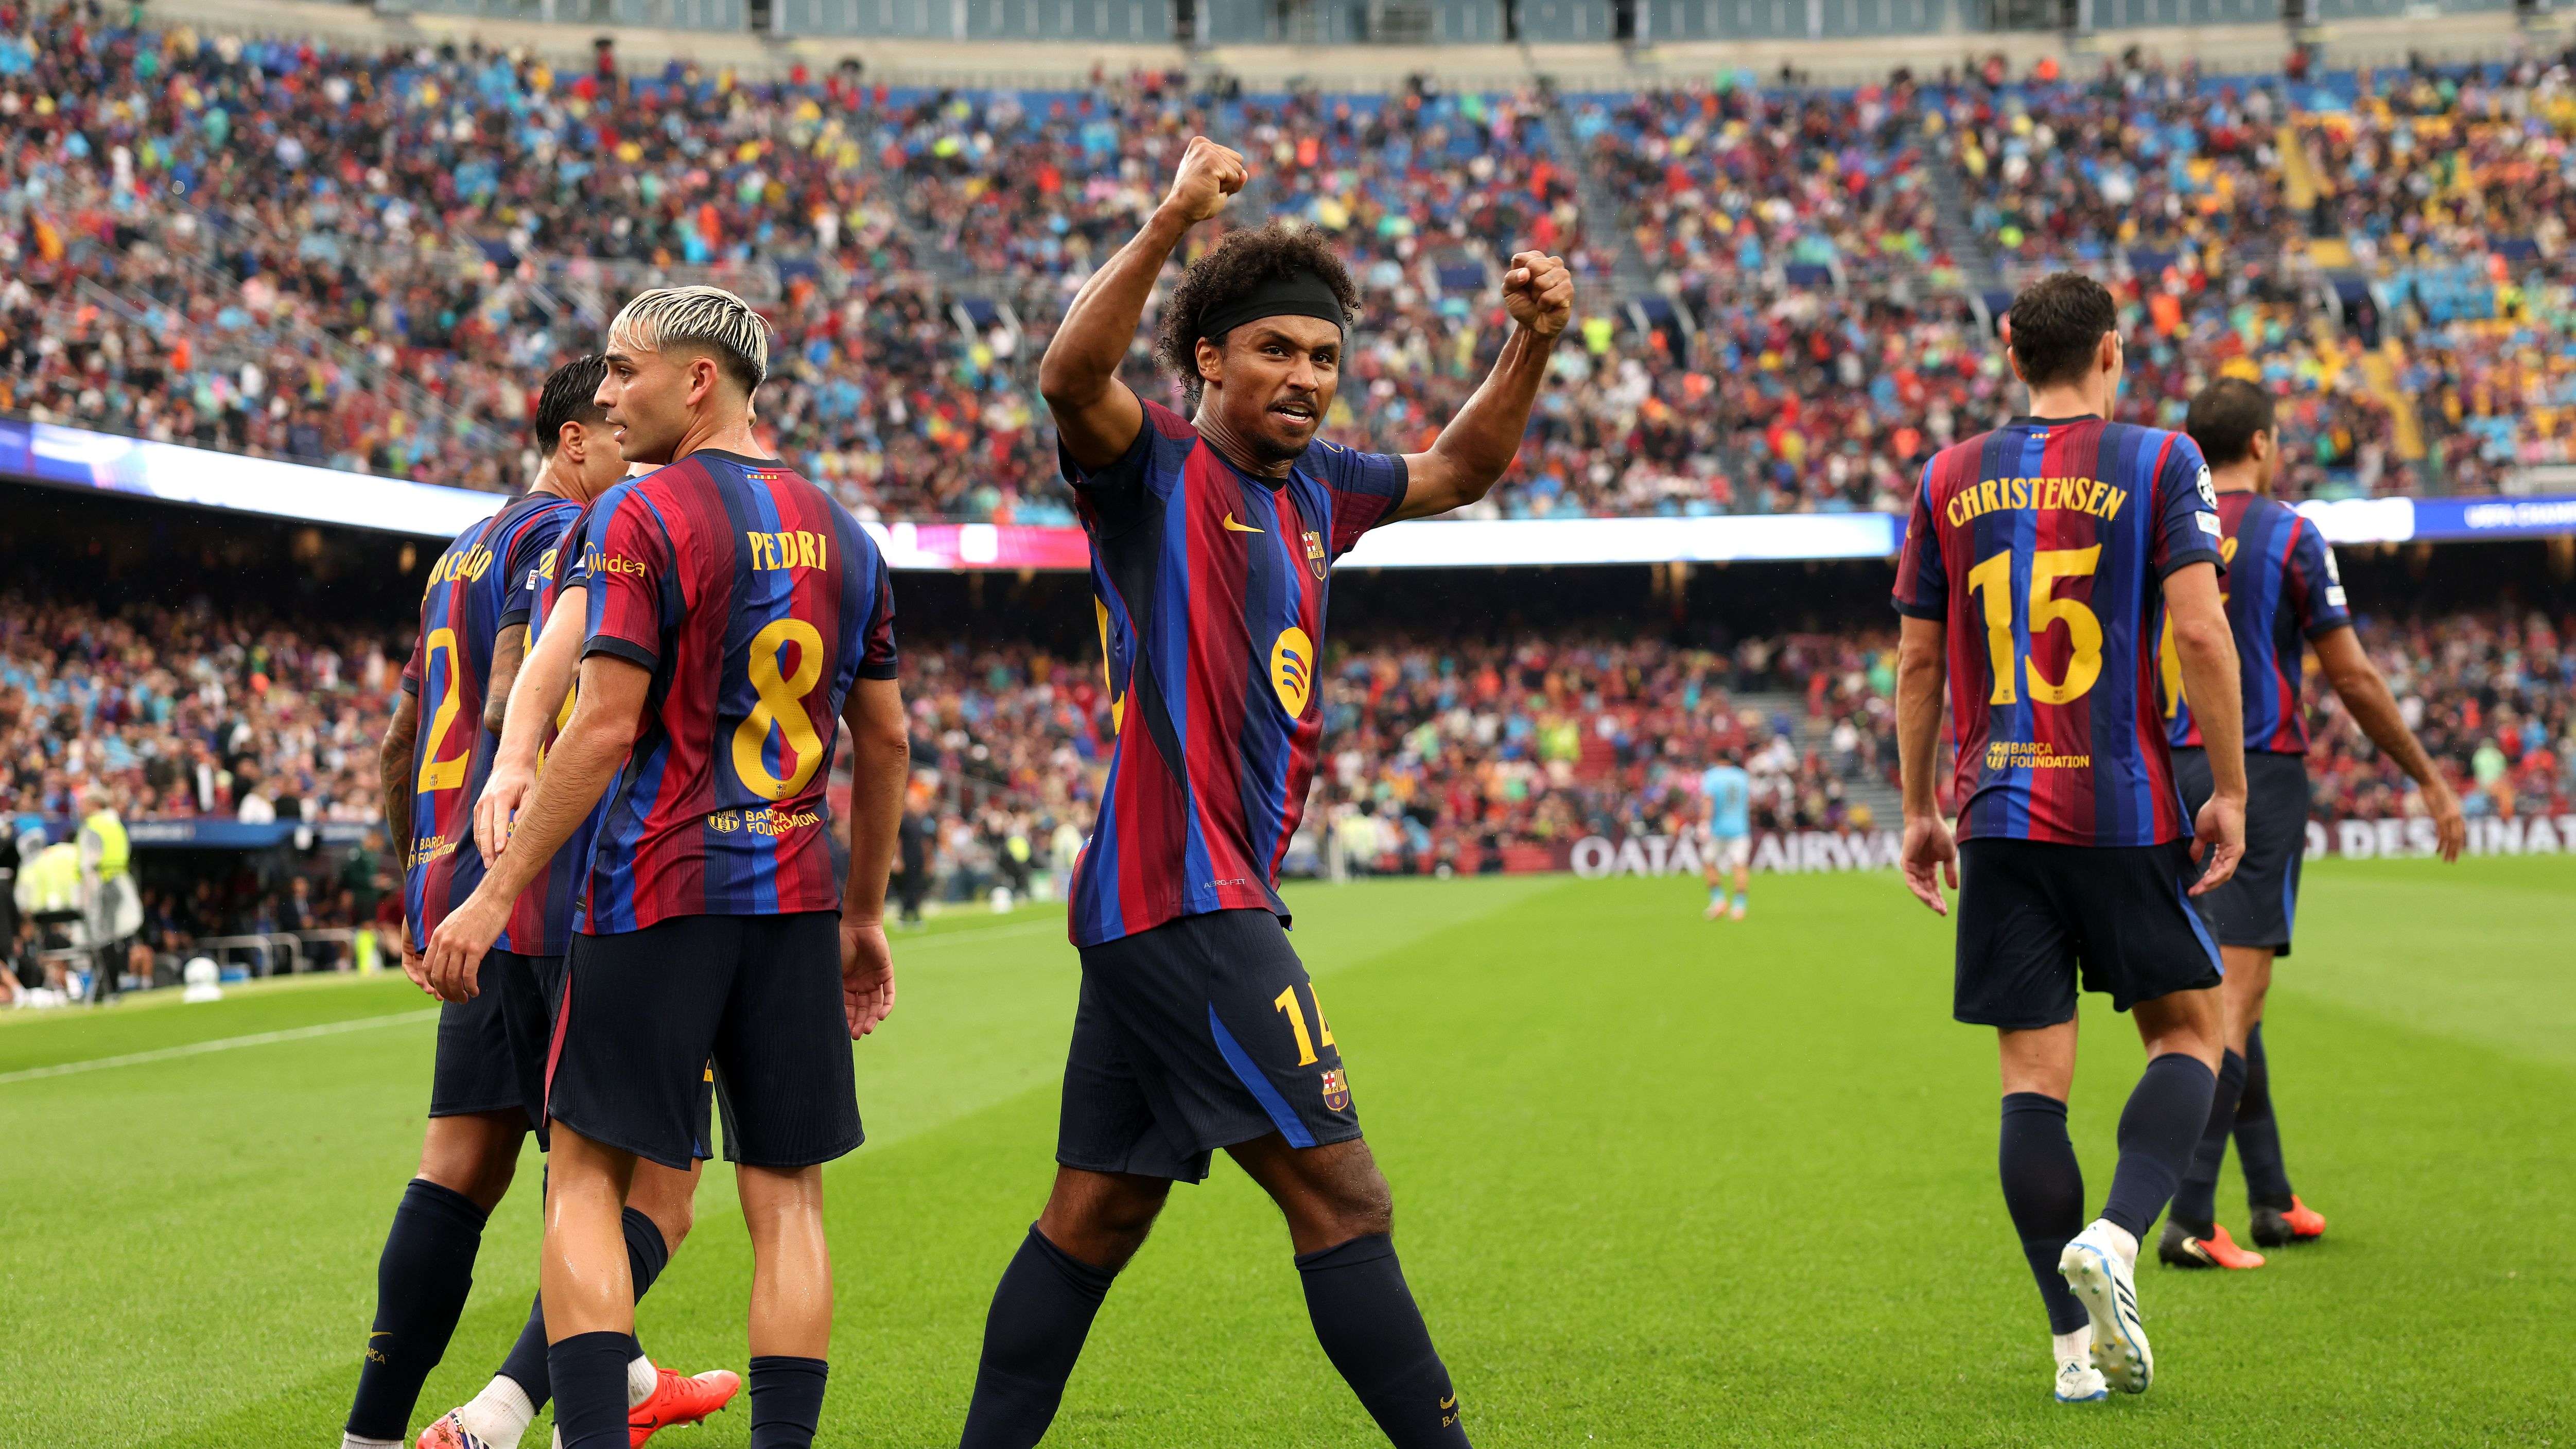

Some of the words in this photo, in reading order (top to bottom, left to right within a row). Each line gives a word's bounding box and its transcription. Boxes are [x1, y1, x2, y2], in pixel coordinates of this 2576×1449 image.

[1946, 477, 2128, 528] CHRISTENSEN
[584, 541, 646, 580] Midea
[746, 530, 827, 571] PEDRI
[1968, 543, 2103, 705] 15
[417, 627, 471, 795] 2
[732, 618, 824, 801] 8
[2010, 742, 2053, 756] BARÇA
[2010, 755, 2090, 769] FOUNDATION
[745, 809, 786, 825] BARÇA
[1750, 830, 1904, 874] AIRWA
[1204, 879, 1245, 889] AERO-FIT
